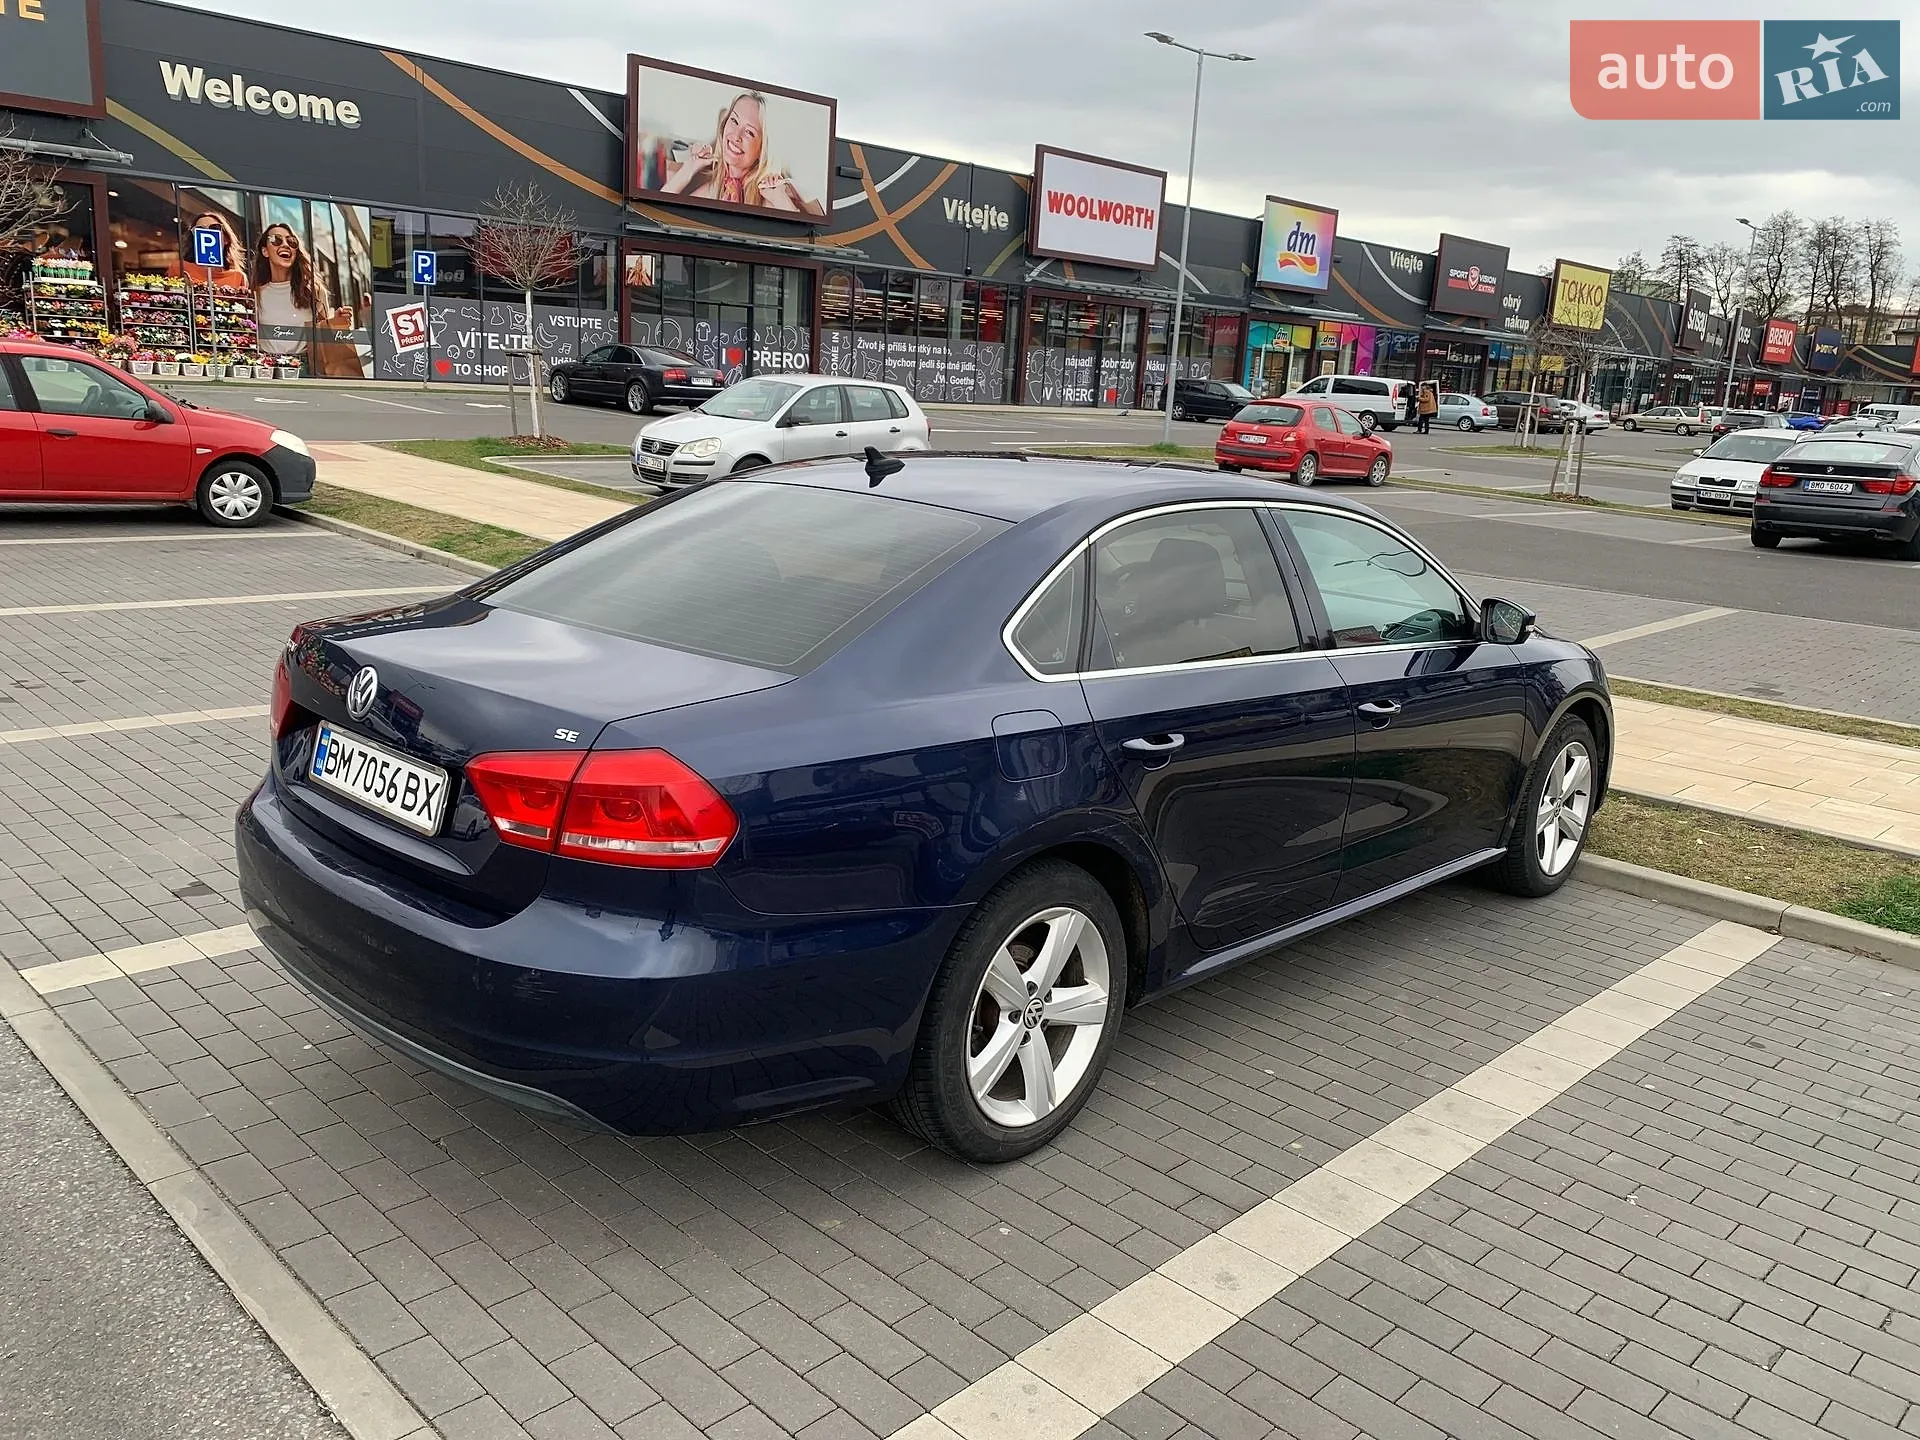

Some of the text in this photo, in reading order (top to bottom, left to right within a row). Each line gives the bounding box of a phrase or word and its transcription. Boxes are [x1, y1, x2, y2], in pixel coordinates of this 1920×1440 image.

[0, 0, 45, 21] E
[159, 60, 361, 126] Welcome
[943, 197, 1009, 232] Vítejte
[1047, 190, 1155, 231] WOOLWORTH
[200, 233, 216, 254] P
[1286, 221, 1317, 255] dm
[417, 254, 431, 274] P
[1390, 251, 1424, 274] Vítejte
[1449, 268, 1497, 285] SPORT VISION
[396, 311, 426, 337] S1
[549, 315, 603, 330] VSTUPTE
[1504, 314, 1530, 334] nákup
[857, 336, 877, 350] Život
[877, 340, 886, 352] je
[887, 341, 907, 353] příliš
[933, 346, 943, 354] na
[1768, 327, 1794, 347] BRENO
[453, 363, 472, 376] TO
[918, 358, 935, 370] jedli
[1146, 359, 1168, 372] Náku
[949, 375, 975, 386] Goethe
[553, 728, 580, 743] SE
[325, 739, 440, 822] BM 7056 BX
